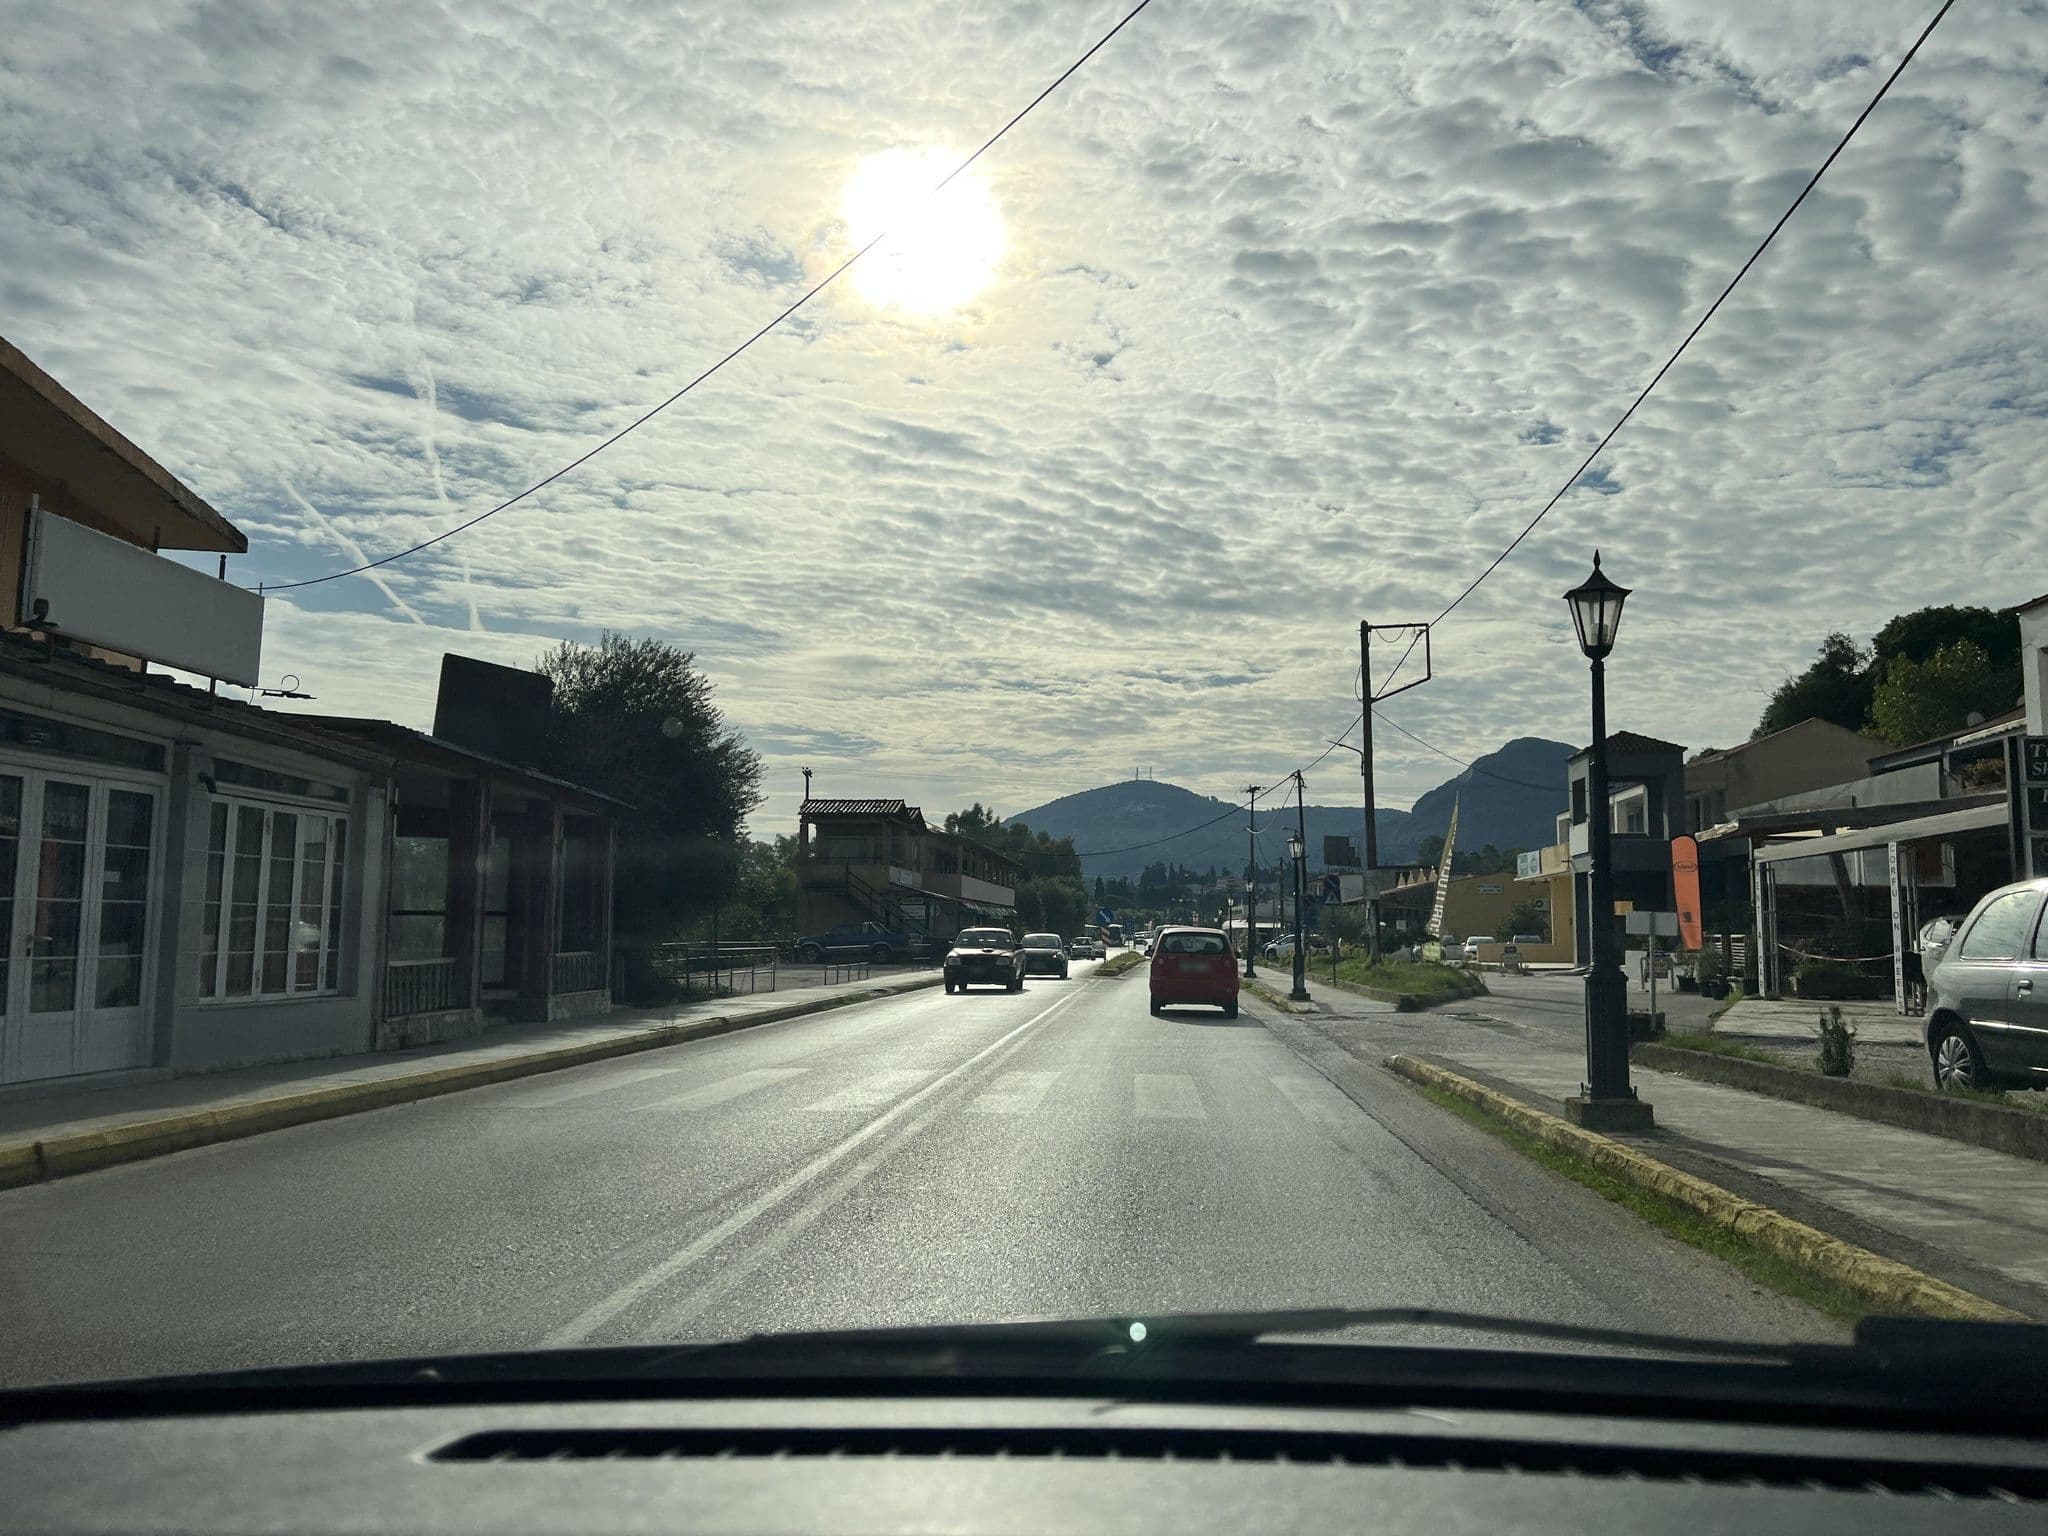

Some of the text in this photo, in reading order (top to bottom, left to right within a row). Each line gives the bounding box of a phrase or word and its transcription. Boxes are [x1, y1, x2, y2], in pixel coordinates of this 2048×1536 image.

[1889, 844, 1904, 1009] CORFU ON WHEELS
